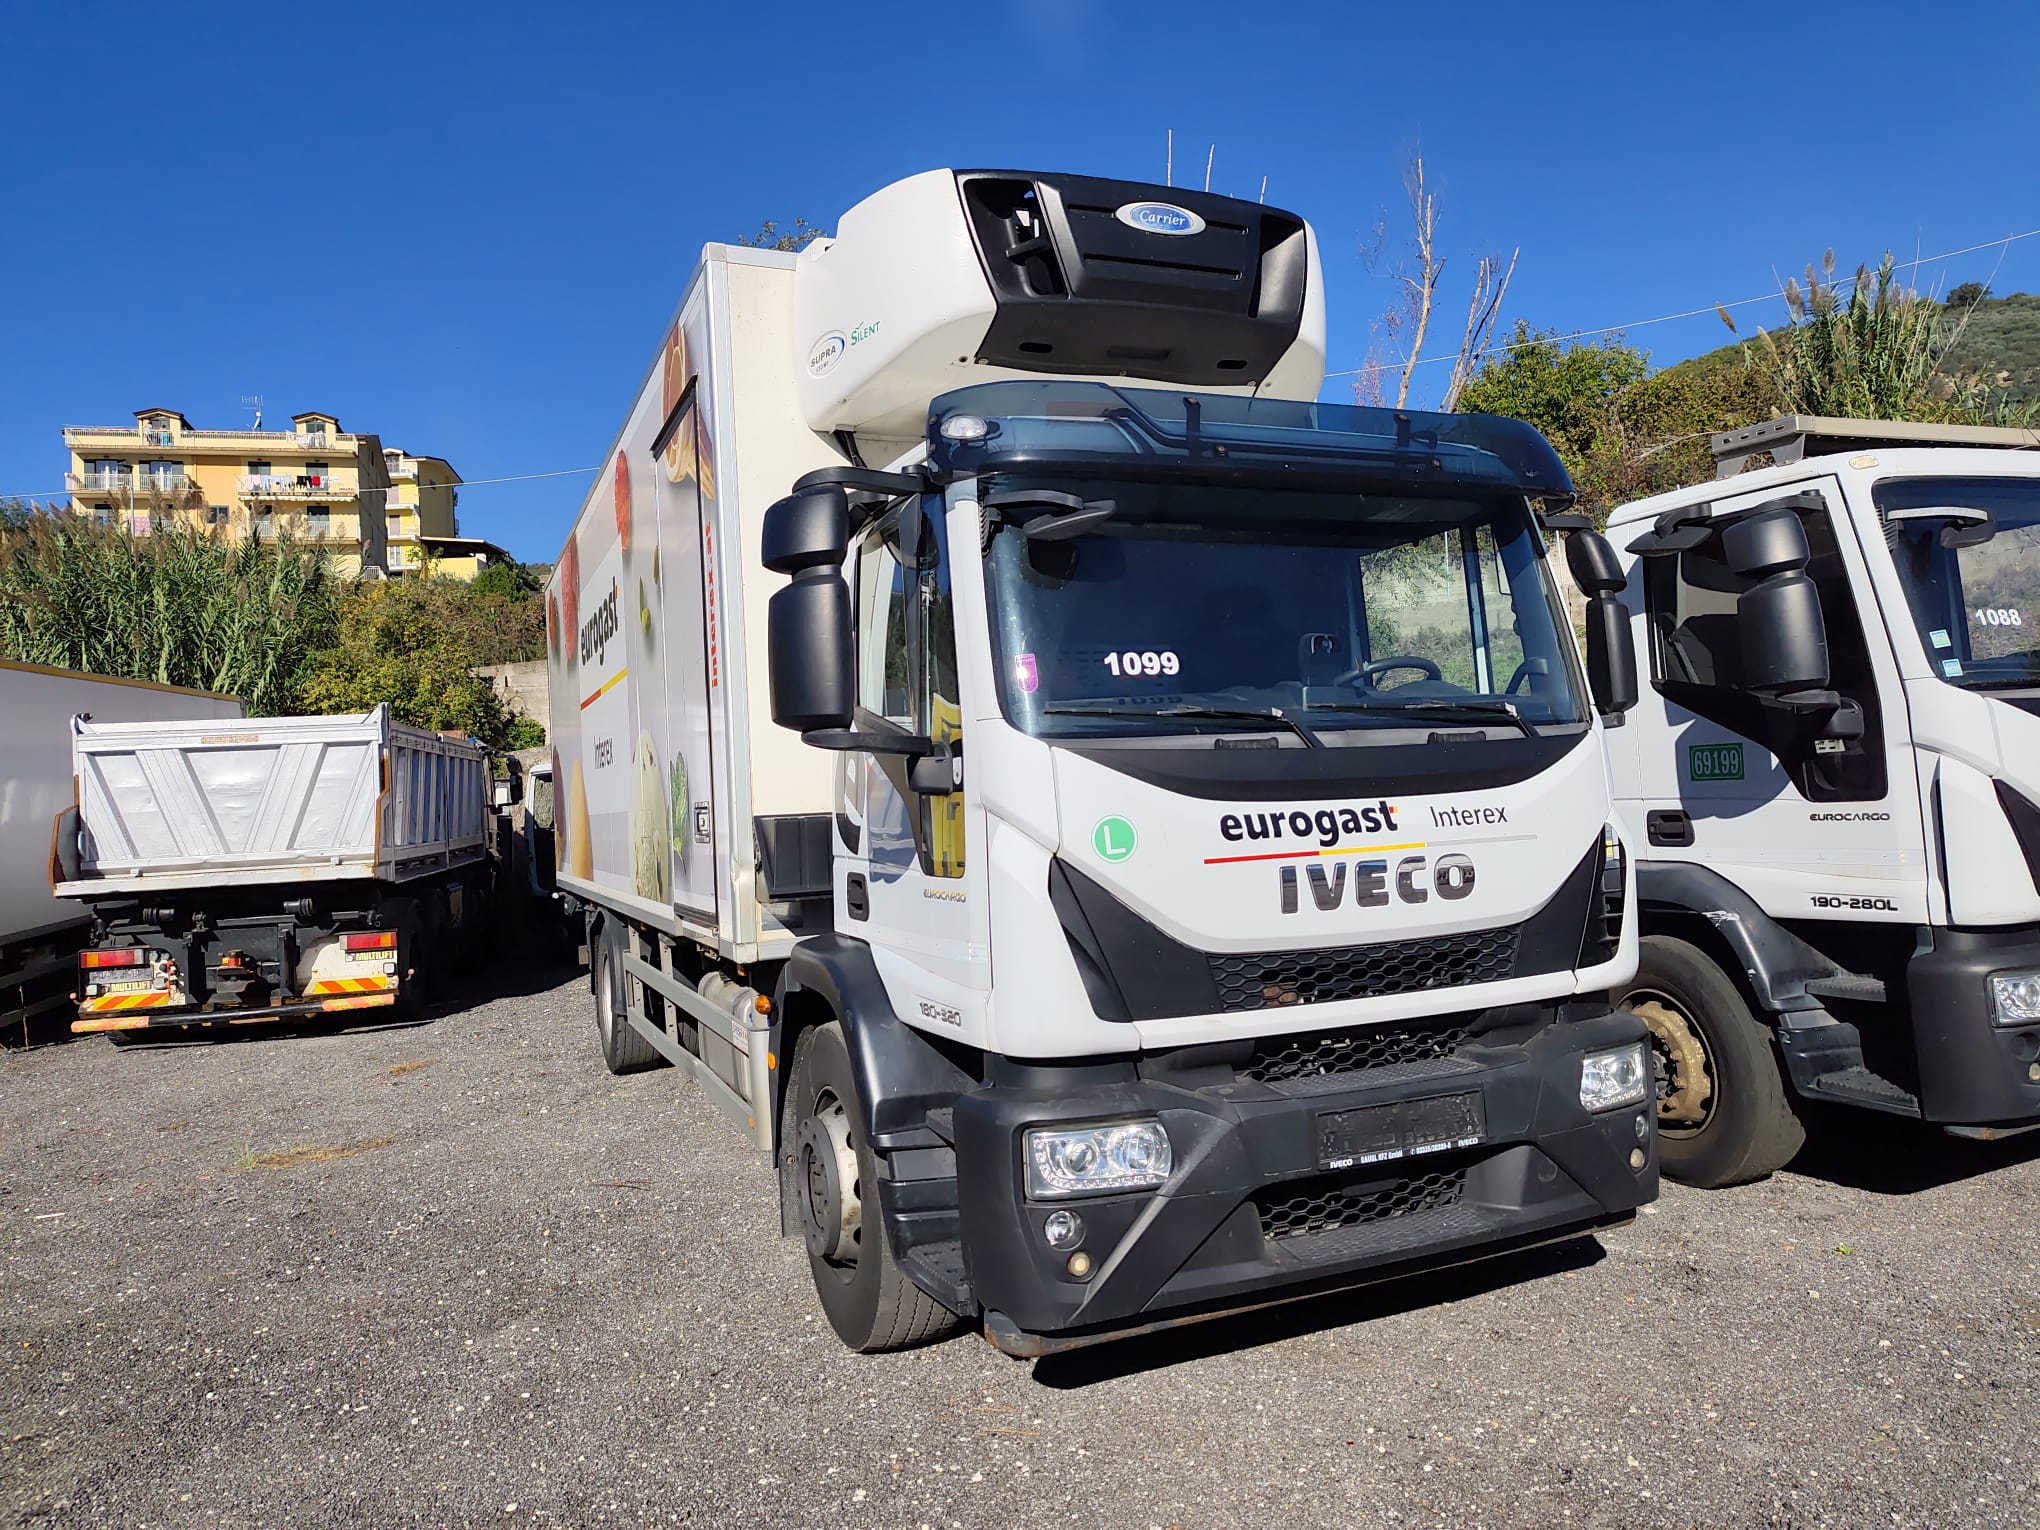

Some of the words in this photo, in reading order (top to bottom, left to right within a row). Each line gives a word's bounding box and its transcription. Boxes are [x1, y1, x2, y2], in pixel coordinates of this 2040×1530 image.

[1139, 210, 1186, 226] Carrier
[850, 321, 881, 346] SILENT
[810, 345, 837, 368] SUPRA
[705, 521, 719, 688] interex.at
[1975, 608, 2022, 626] 1088
[581, 575, 619, 667] eurogast
[1103, 651, 1180, 676] 1099
[1694, 749, 1739, 775] 69199
[1220, 800, 1399, 846] eurogast
[1430, 804, 1508, 828] Interex
[1809, 812, 1891, 822] EUROCARGO
[1104, 825, 1127, 855] L
[922, 888, 967, 903] EUROCARGO
[1279, 852, 1476, 915] IVECO
[1809, 896, 1898, 912] 190-280L
[919, 1001, 962, 1027] 180-320
[1330, 1158, 1353, 1169] IVECO
